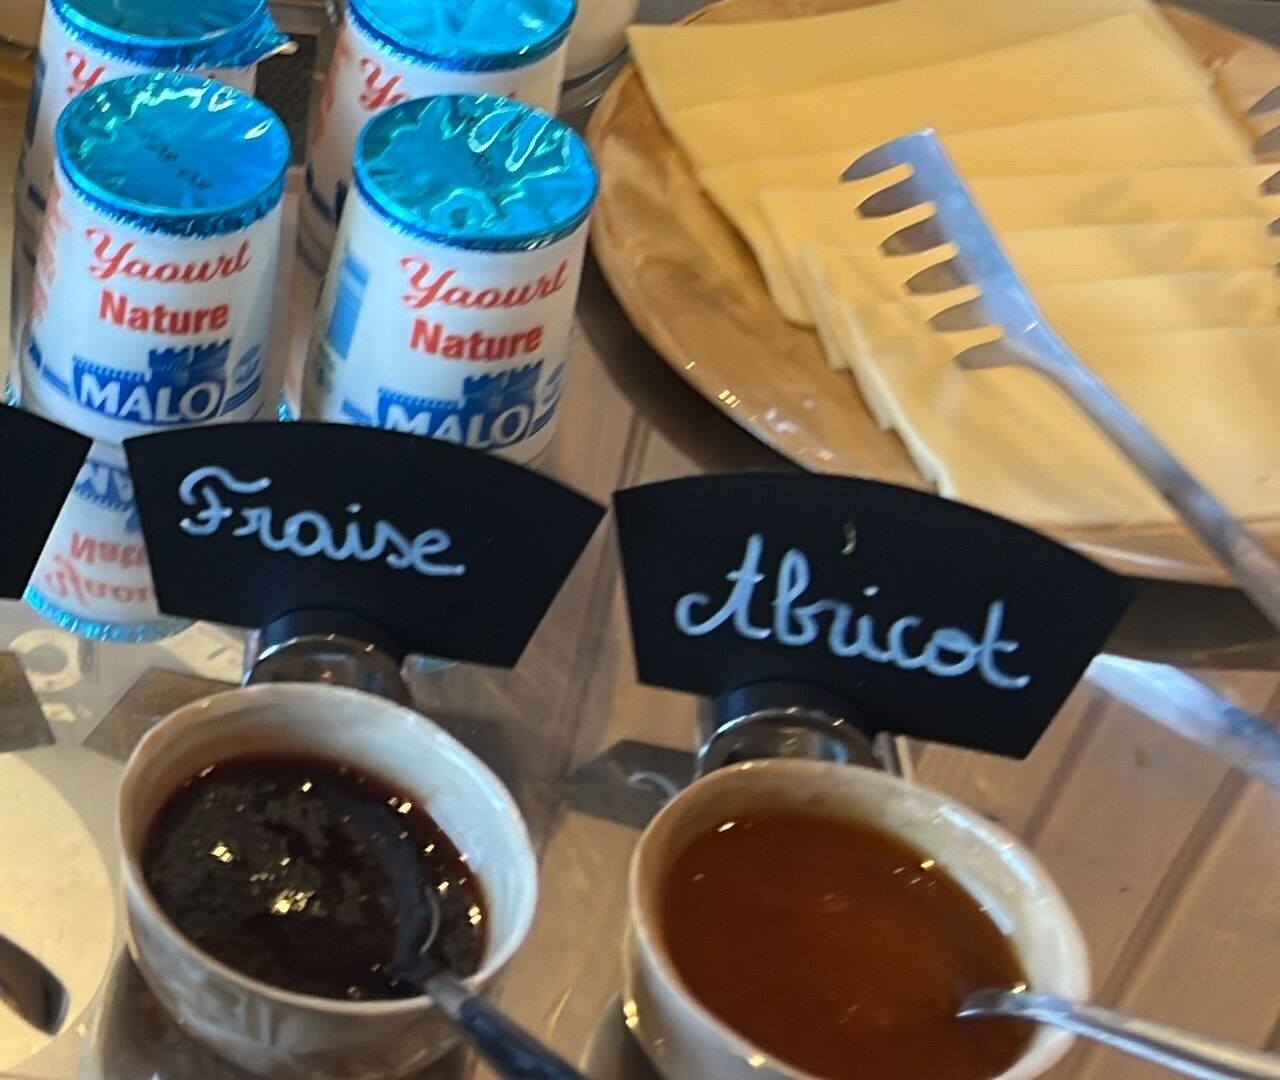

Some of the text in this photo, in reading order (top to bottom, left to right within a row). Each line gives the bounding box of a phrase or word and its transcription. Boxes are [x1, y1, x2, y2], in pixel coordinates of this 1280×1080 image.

[85, 225, 251, 284] Yaourt
[398, 255, 569, 310] Yaourt
[99, 289, 229, 335] Nature
[410, 317, 543, 363] Nature
[78, 370, 224, 421] MALO
[384, 401, 534, 450] MALO
[177, 465, 466, 576] Fraise
[675, 534, 1031, 691] Abricot
